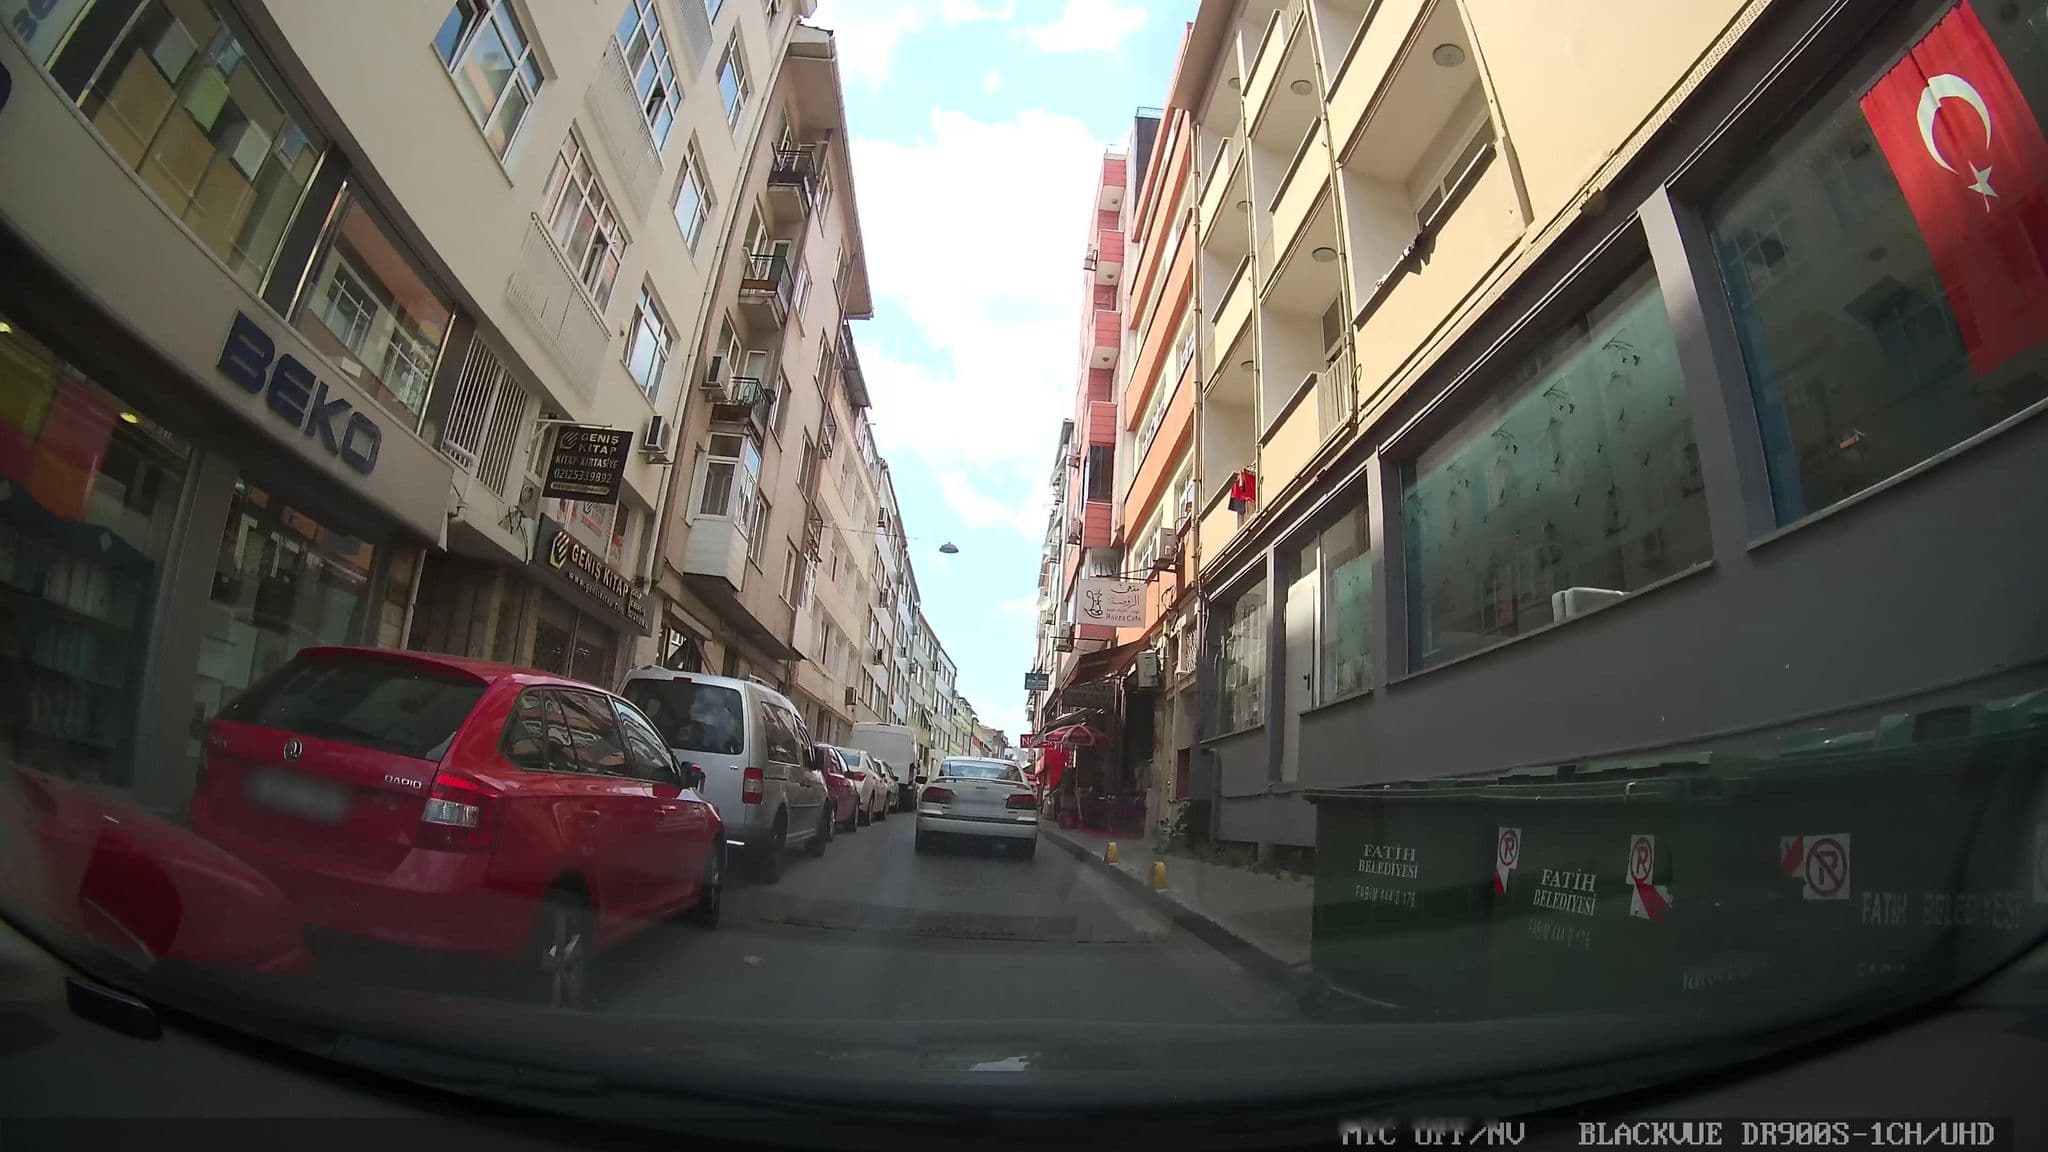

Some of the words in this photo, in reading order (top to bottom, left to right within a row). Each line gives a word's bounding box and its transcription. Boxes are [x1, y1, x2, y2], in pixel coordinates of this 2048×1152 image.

[216, 310, 382, 474] BEKO
[1540, 868, 1597, 892] FATİH
[1533, 889, 1597, 916] BELEDİYESİ
